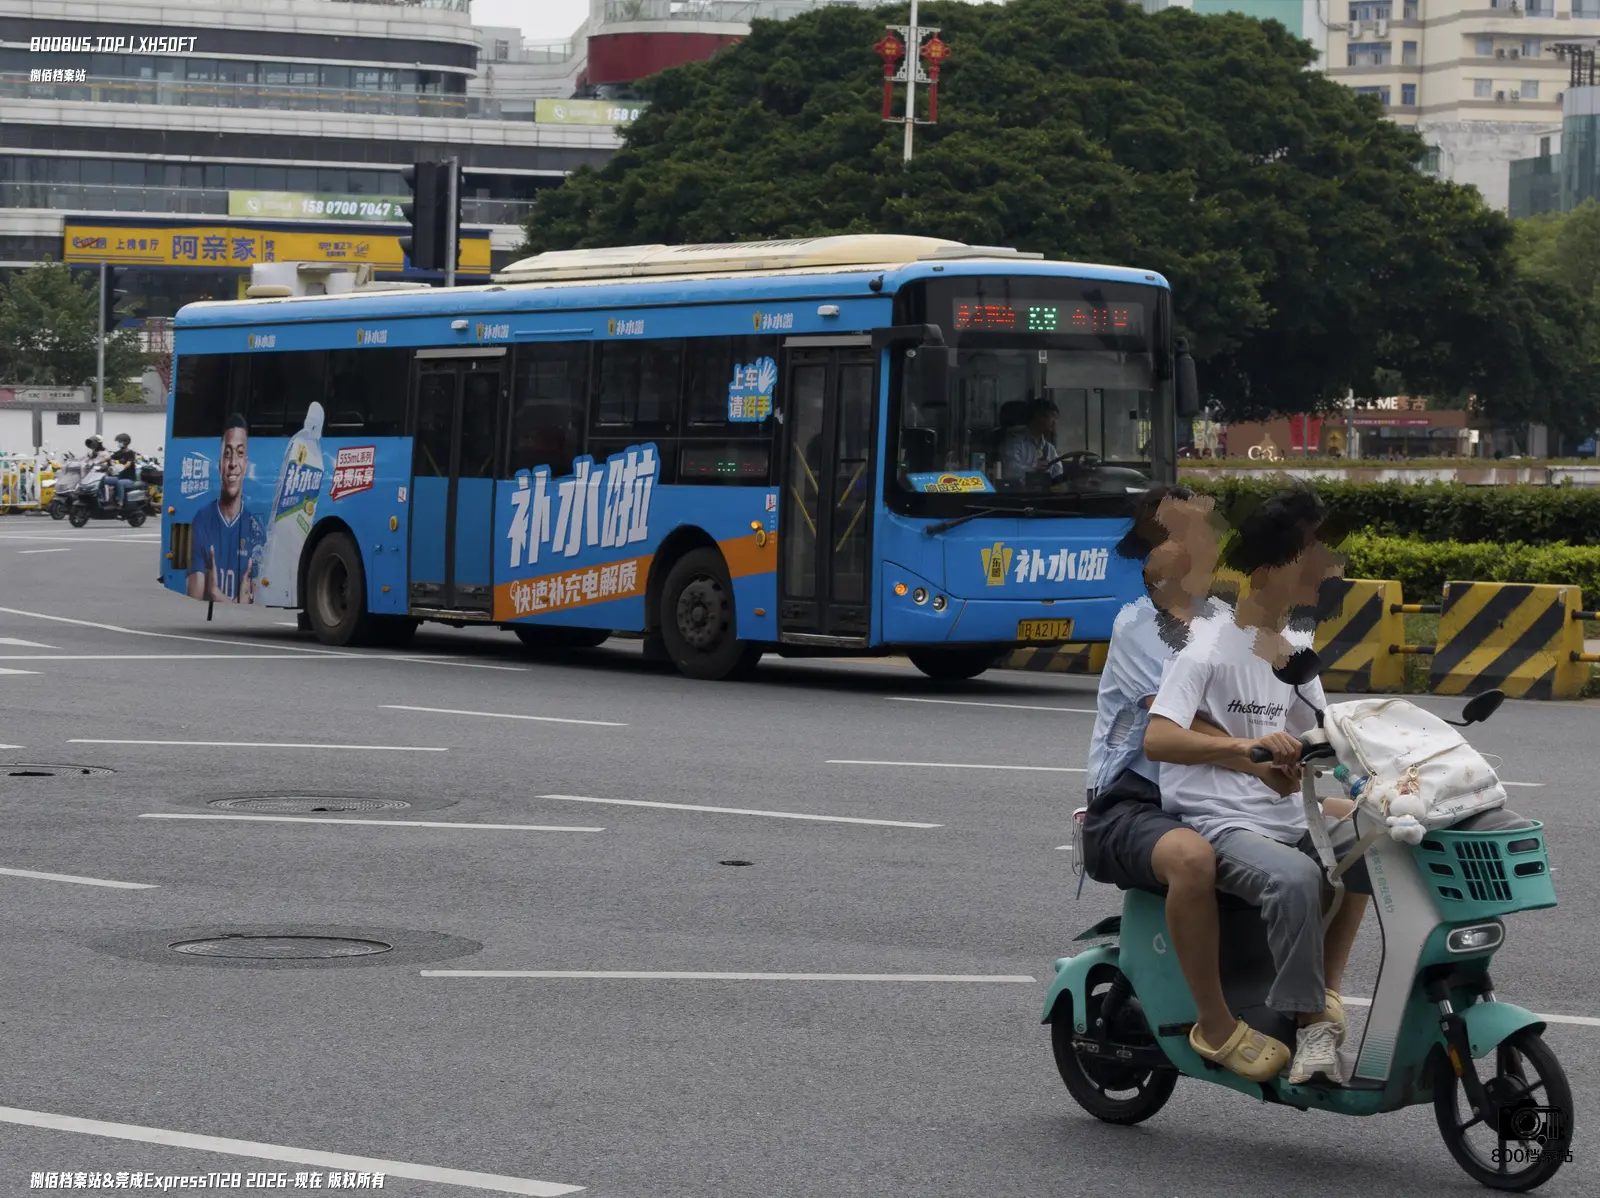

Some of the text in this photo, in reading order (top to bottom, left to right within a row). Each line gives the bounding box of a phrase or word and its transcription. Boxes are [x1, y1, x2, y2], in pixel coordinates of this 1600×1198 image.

[301, 200, 324, 214] 158
[325, 201, 357, 215] 0700
[359, 202, 391, 216] 7047
[172, 235, 256, 261] 阿亲家
[731, 367, 758, 391] 上车
[730, 395, 771, 419] 请招手
[340, 451, 372, 465] 555mL系列
[331, 467, 374, 494] 免费乐享
[507, 449, 656, 568] 补水啦
[1014, 548, 1109, 583] 补水啦
[514, 560, 637, 614] 快速补充电解质
